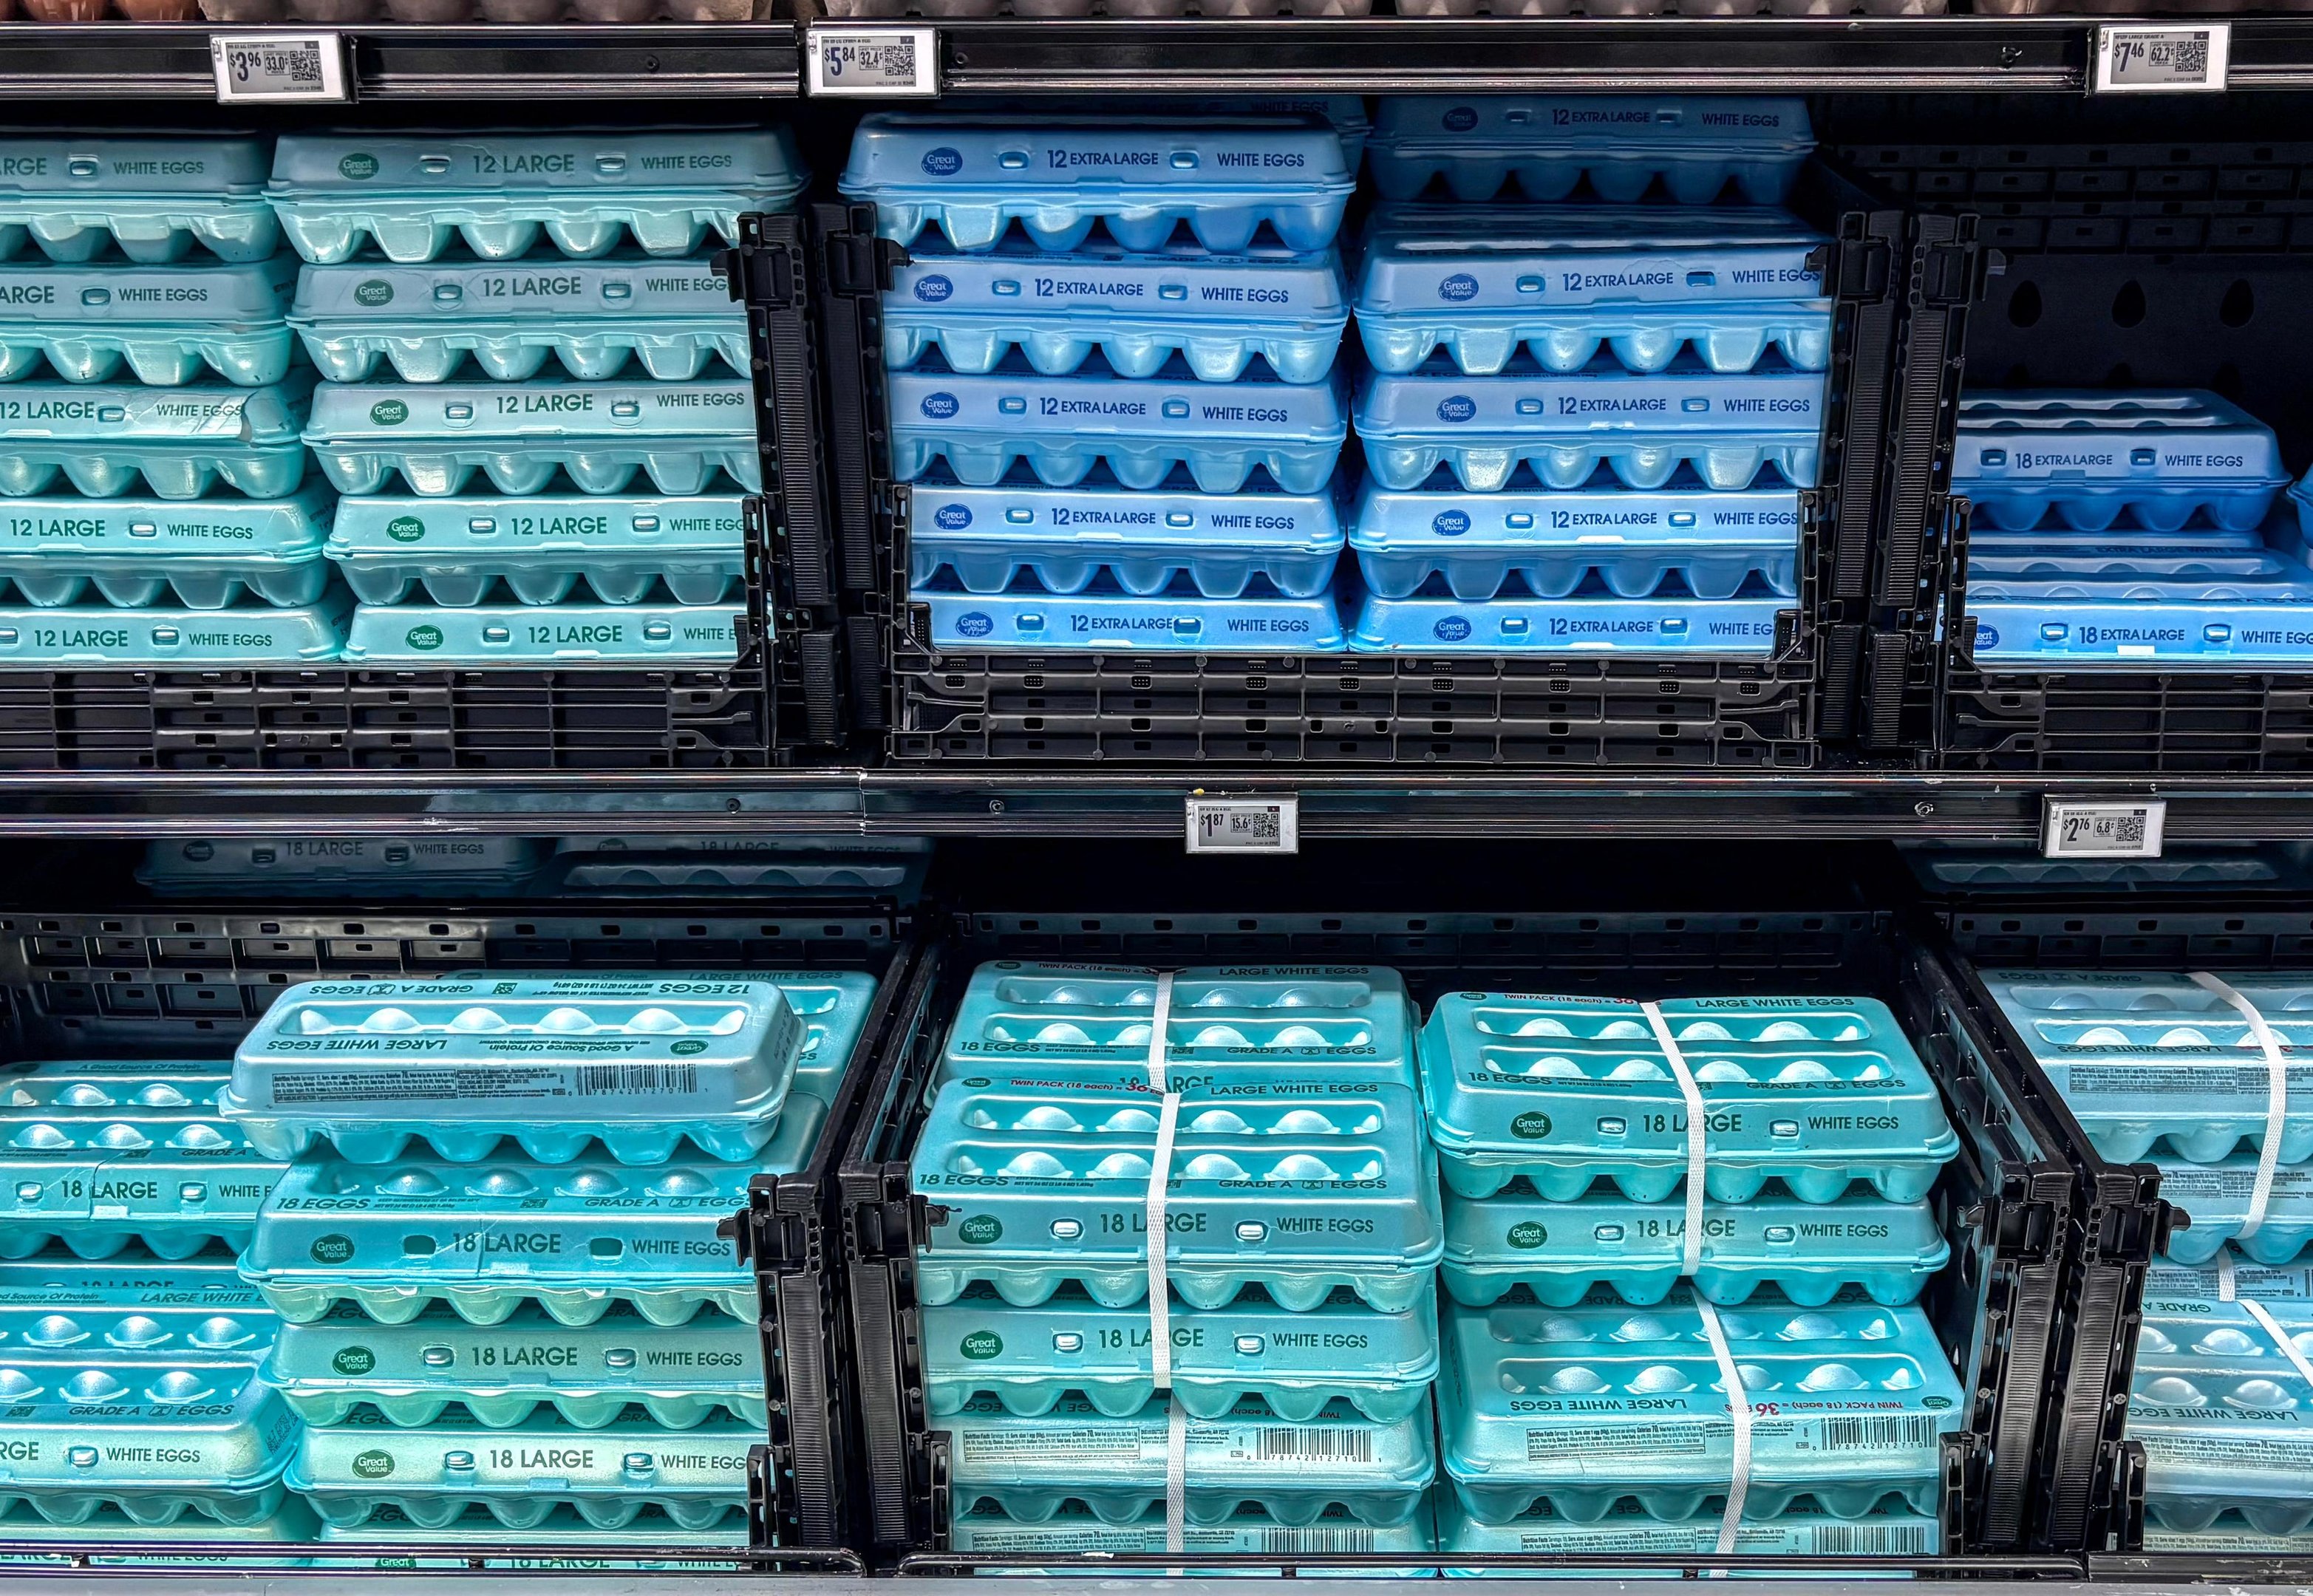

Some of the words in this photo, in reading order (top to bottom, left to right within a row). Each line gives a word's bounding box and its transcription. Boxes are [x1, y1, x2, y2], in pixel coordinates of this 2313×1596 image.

[1553, 109, 1569, 125] 12
[1572, 112, 1609, 122] EXTRA
[1611, 112, 1649, 123] LARGE
[1702, 114, 1739, 125] WHITE
[1743, 115, 1779, 127] EGGS
[473, 155, 496, 173] 12
[504, 154, 574, 173] LARGE
[641, 156, 684, 169] WHITE
[689, 155, 732, 168] EGGS
[1048, 150, 1067, 168] 12
[1071, 153, 1112, 165] EXTRA
[1114, 153, 1158, 165] LARGE
[1217, 153, 1258, 166] WHITE
[1264, 154, 1304, 166] EGGS
[1563, 273, 1581, 291] 12
[1586, 274, 1626, 287] EXTRA
[1629, 273, 1673, 285] LARGE
[1732, 270, 1774, 283] WHITE
[1779, 270, 1820, 282] EGGS
[1445, 282, 1471, 292] Great
[0, 286, 55, 304] ARGE
[119, 289, 161, 301] WHITE
[166, 289, 207, 301] EGGS
[497, 396, 518, 413] 12
[525, 394, 593, 412] LARGE
[657, 395, 698, 406] WHITE
[704, 392, 744, 406] EGGS
[0, 402, 20, 418] 12
[28, 401, 94, 418] LARGE
[157, 405, 199, 416] WHITE
[203, 405, 243, 417] EGGS
[376, 403, 403, 415] Great
[1040, 398, 1057, 415] 12
[1062, 401, 1101, 413] EXTRA
[1103, 403, 1145, 415] LARGE
[1203, 407, 1243, 420] WHITE
[1248, 409, 1287, 422] EGGS
[2016, 453, 2032, 468] 18
[2036, 455, 2071, 466] EXTRA
[2074, 455, 2112, 465] LARGE
[2165, 455, 2202, 466] WHITE
[2207, 456, 2242, 466] EGGS
[35, 630, 55, 646] 12
[63, 630, 128, 647] LARGE
[189, 634, 228, 645] WHITE
[234, 635, 272, 646] EGGS
[2079, 627, 2097, 644] 18
[2102, 630, 2140, 640] EXTRA
[2142, 630, 2184, 640] LARGE
[2242, 631, 2282, 643] WHITE
[2286, 632, 2313, 644] EGG
[286, 842, 303, 856] 18
[308, 841, 364, 856] LARGE
[414, 845, 447, 853] WHITE
[452, 845, 483, 854] EGGS
[659, 983, 725, 993] EGGS
[727, 985, 749, 994] 12
[267, 1041, 322, 1050] EGGS
[324, 1040, 378, 1050] WHITE
[384, 1040, 447, 1049] LARGE
[489, 1043, 528, 1051] Protein
[547, 1044, 586, 1052] Source
[1469, 1072, 1488, 1080] 18
[1493, 1074, 1552, 1085] EGGS
[1211, 1086, 1267, 1094] LARGE
[1273, 1085, 1323, 1094] WHITE
[1643, 1115, 1665, 1132] 18
[1808, 1116, 1852, 1129] WHITE
[1857, 1116, 1898, 1129] EGGS
[919, 1175, 939, 1184] 18
[944, 1175, 1009, 1185] EGGS
[1219, 1180, 1275, 1188] GRADE
[1331, 1180, 1387, 1188] EGGS
[62, 1180, 82, 1197] 18
[92, 1181, 157, 1199] LARGE
[219, 1185, 259, 1197] WHITE
[276, 1198, 299, 1210] 18
[304, 1198, 371, 1210] EGGS
[965, 1223, 995, 1232] Great
[1101, 1214, 1124, 1232] 18
[1132, 1213, 1207, 1232] LRGE
[1277, 1218, 1323, 1231] WHITE
[1329, 1219, 1373, 1232] EGGS
[452, 1233, 474, 1253] 18
[485, 1232, 561, 1253] LARGE
[632, 1239, 679, 1254] WHITE
[684, 1241, 730, 1256] EGGS
[140, 1293, 200, 1303] LARGE
[203, 1293, 254, 1302] WHITE
[338, 1354, 368, 1364] Great
[472, 1347, 495, 1365] 18
[504, 1347, 577, 1365] LARGE
[647, 1352, 692, 1365] WHITE
[698, 1353, 742, 1365] EGGS
[69, 1407, 128, 1415] GRADE
[127, 1406, 140, 1415] A
[176, 1405, 234, 1415] EGGS
[1510, 1401, 1562, 1411] EGGS
[1567, 1400, 1622, 1410] WHITE
[1626, 1399, 1686, 1409] LARGE
[1755, 1403, 1779, 1416] 36
[2128, 1408, 2170, 1417] EGG
[2176, 1408, 2232, 1419] WHITE
[2238, 1411, 2297, 1421] LARGE
[106, 1447, 151, 1461] WHITE
[157, 1449, 200, 1462] EGGS
